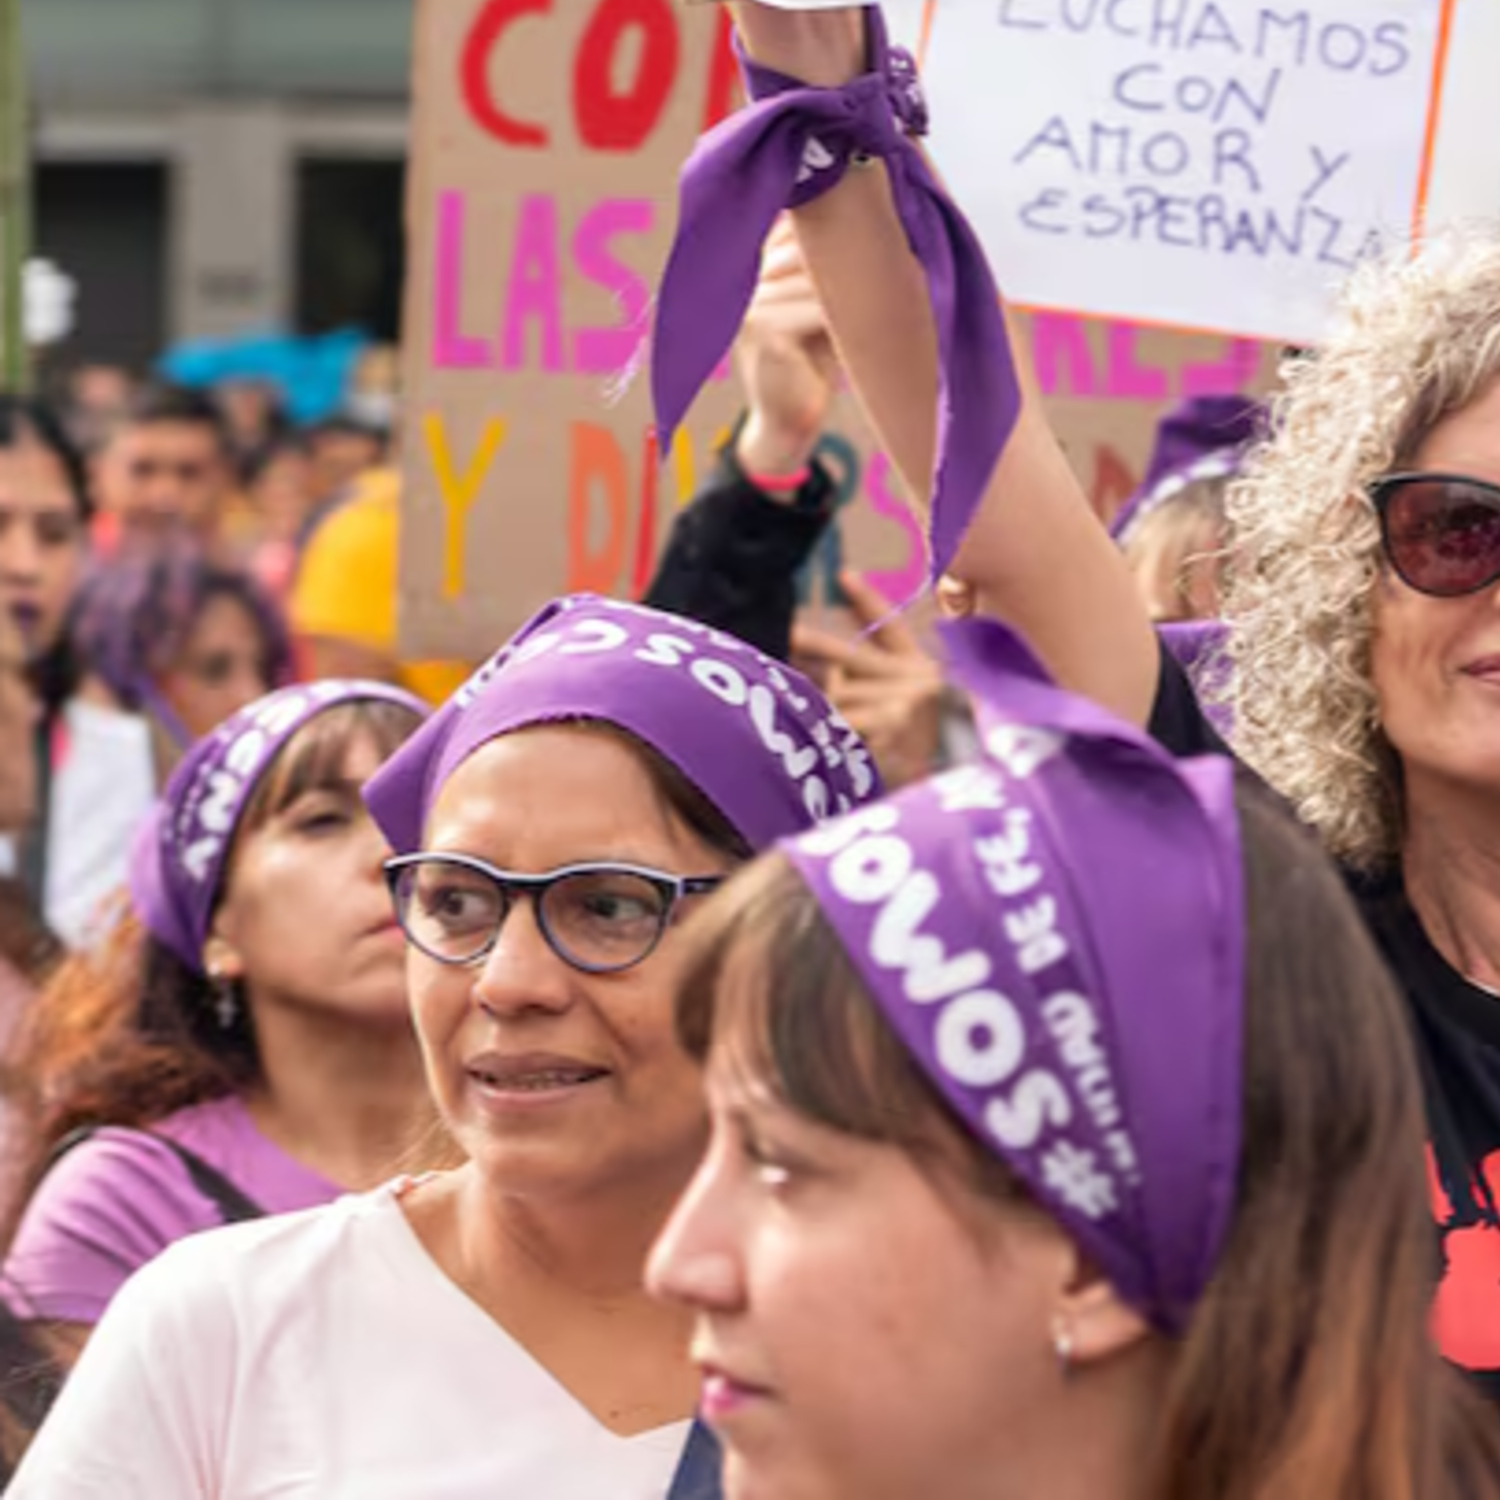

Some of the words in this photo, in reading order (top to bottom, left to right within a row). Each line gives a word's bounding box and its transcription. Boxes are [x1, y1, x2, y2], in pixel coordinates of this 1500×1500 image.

[1012, 115, 1262, 193] AMOR
[1301, 145, 1351, 201] Y
[1112, 62, 1282, 124] CON
[430, 188, 656, 375] LAS
[401, 412, 508, 599] Y
